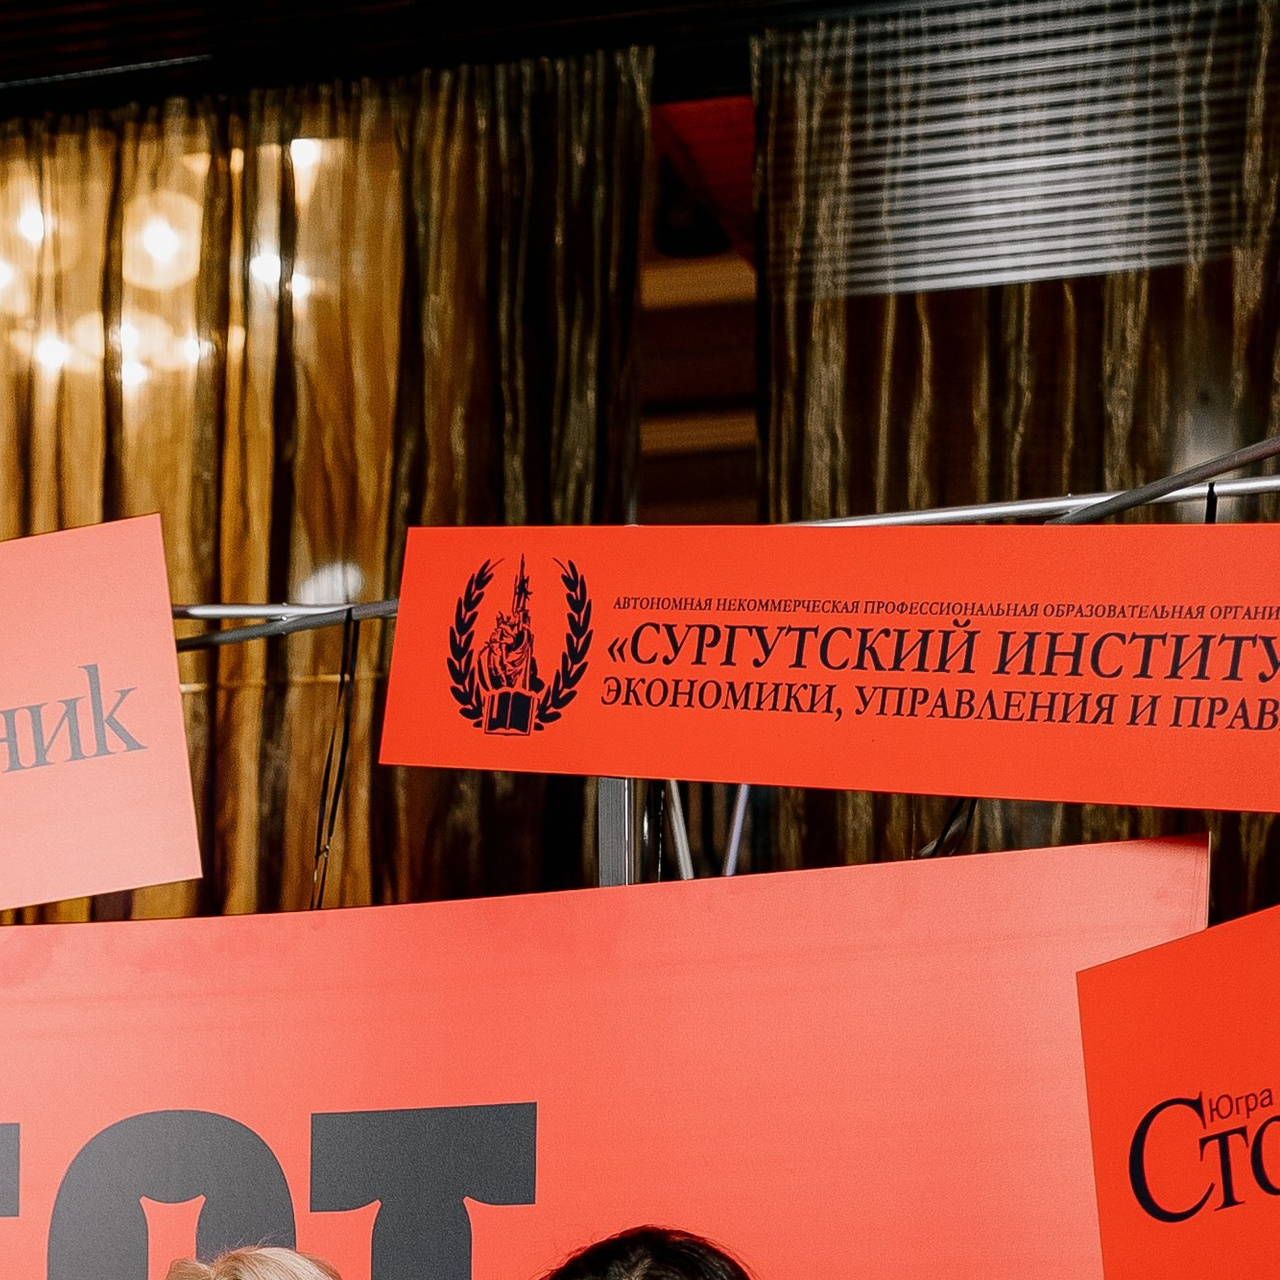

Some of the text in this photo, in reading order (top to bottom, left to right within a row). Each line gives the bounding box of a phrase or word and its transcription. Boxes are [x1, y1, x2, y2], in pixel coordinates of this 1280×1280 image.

[613, 596, 712, 612] АВТОНОМНАЯ
[716, 598, 860, 615] НЕКОММЕРЧЕСКАЯ
[863, 600, 1039, 618] ПРОФЕССИОНАЛЬНАЯ
[1043, 604, 1205, 620] ОБРАЗОВАТЕЛЬНАЯ
[607, 619, 982, 674] «СУРГУТСКИЙ
[601, 676, 843, 723] ЭКОНОМИКИ,
[853, 686, 1119, 727] УПРАВЛЕНИЯ
[1126, 694, 1158, 728] И
[1208, 1087, 1275, 1124] Югра
